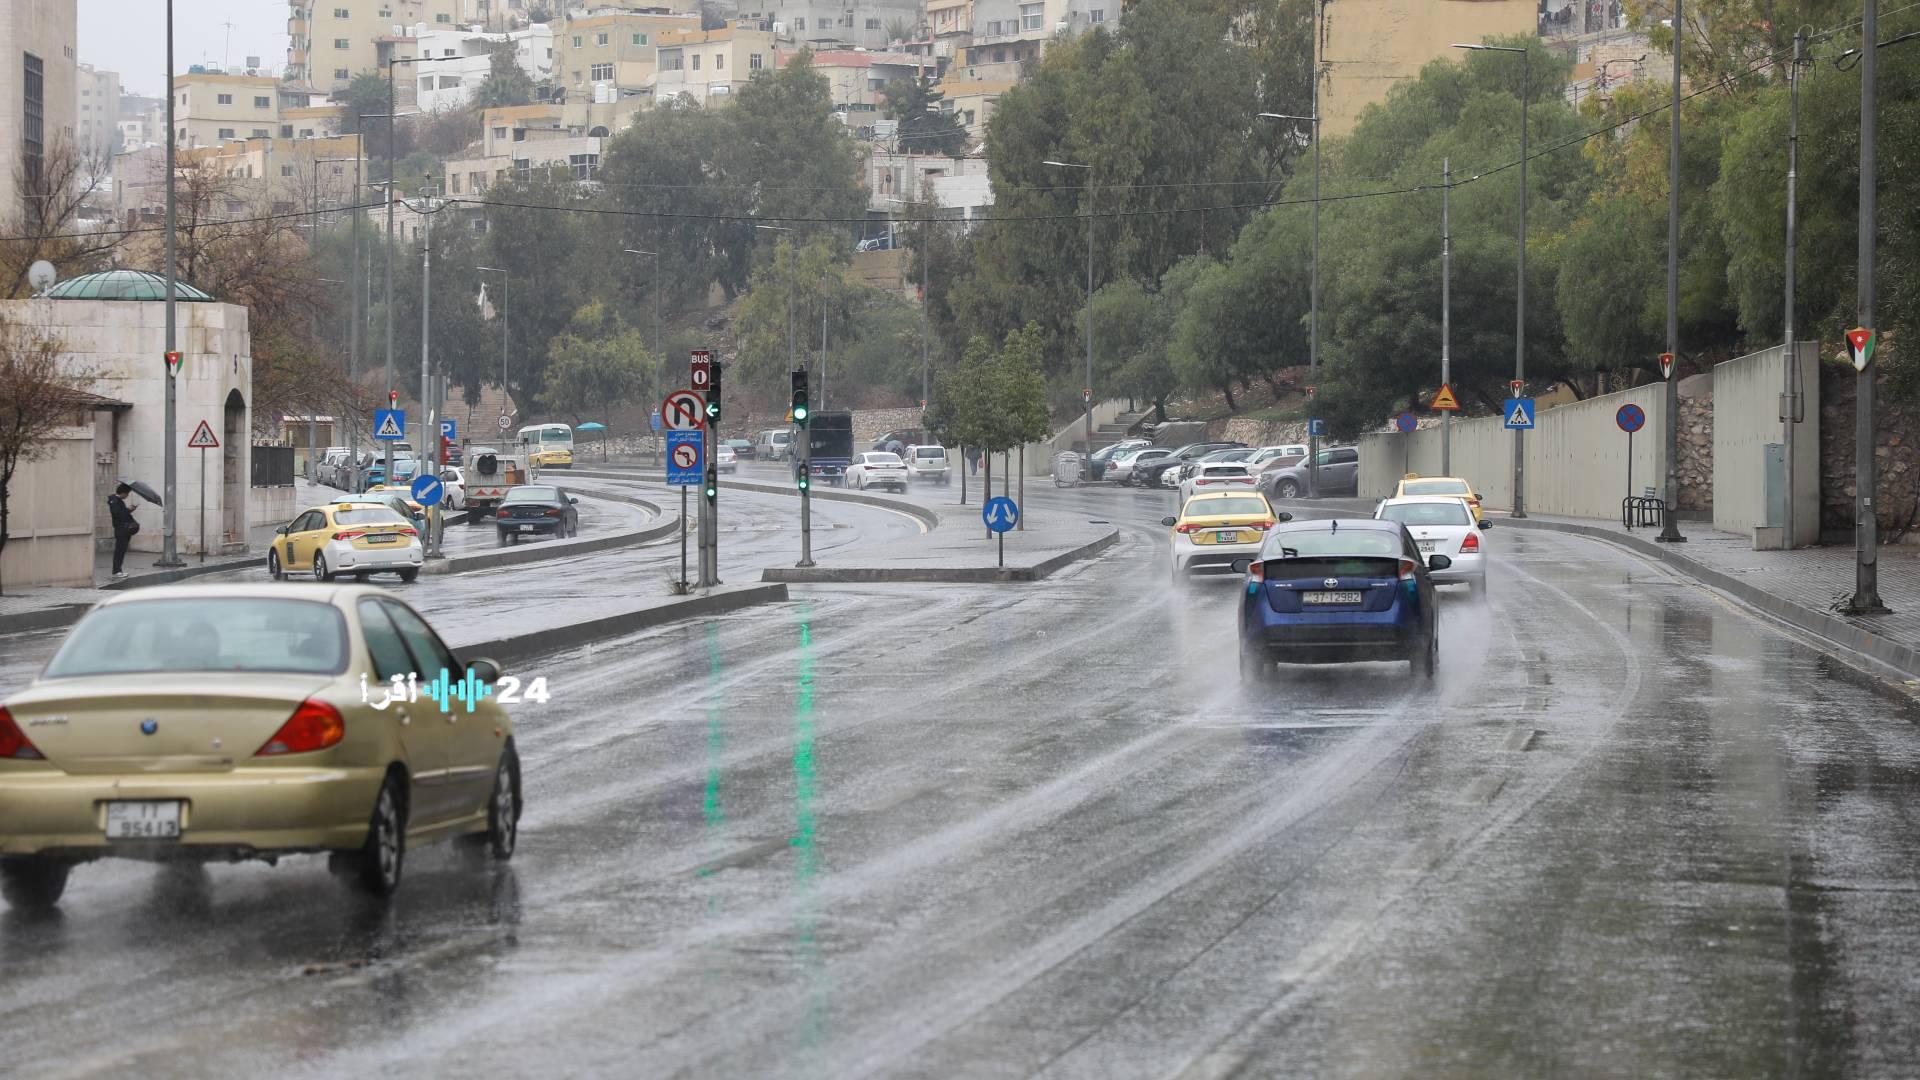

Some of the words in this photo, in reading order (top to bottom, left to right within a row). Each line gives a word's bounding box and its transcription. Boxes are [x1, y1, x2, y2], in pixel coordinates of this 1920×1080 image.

[691, 354, 709, 364] BUS
[500, 418, 510, 426] 50
[440, 423, 452, 437] P
